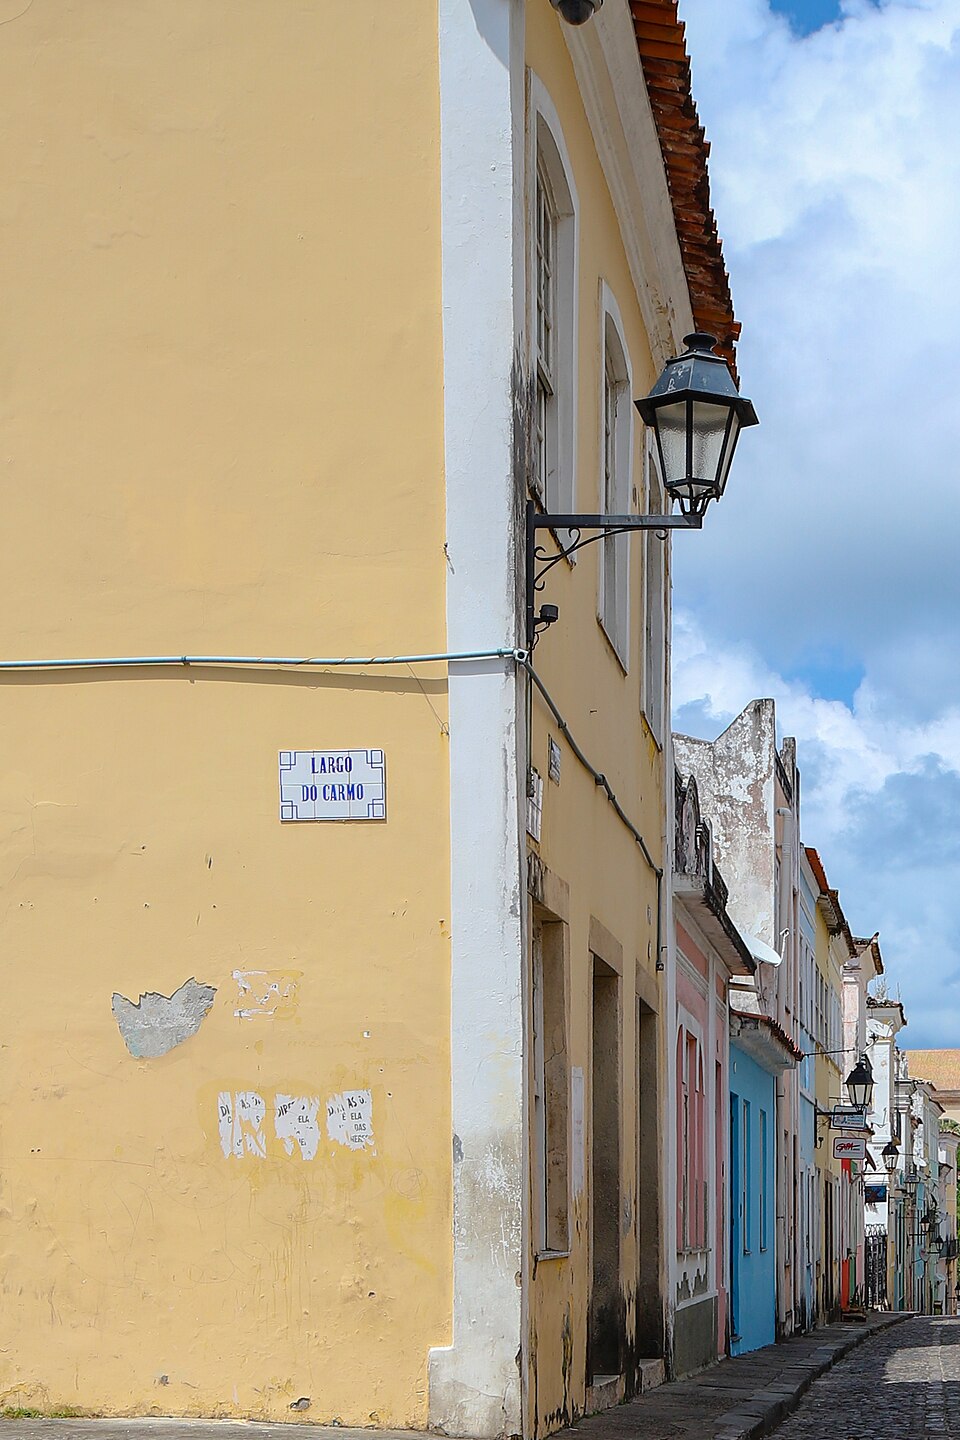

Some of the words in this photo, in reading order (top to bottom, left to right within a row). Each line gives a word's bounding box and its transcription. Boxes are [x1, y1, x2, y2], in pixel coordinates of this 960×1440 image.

[311, 756, 353, 774] LARGO
[302, 784, 318, 802] DO
[323, 783, 364, 801] CARMO
